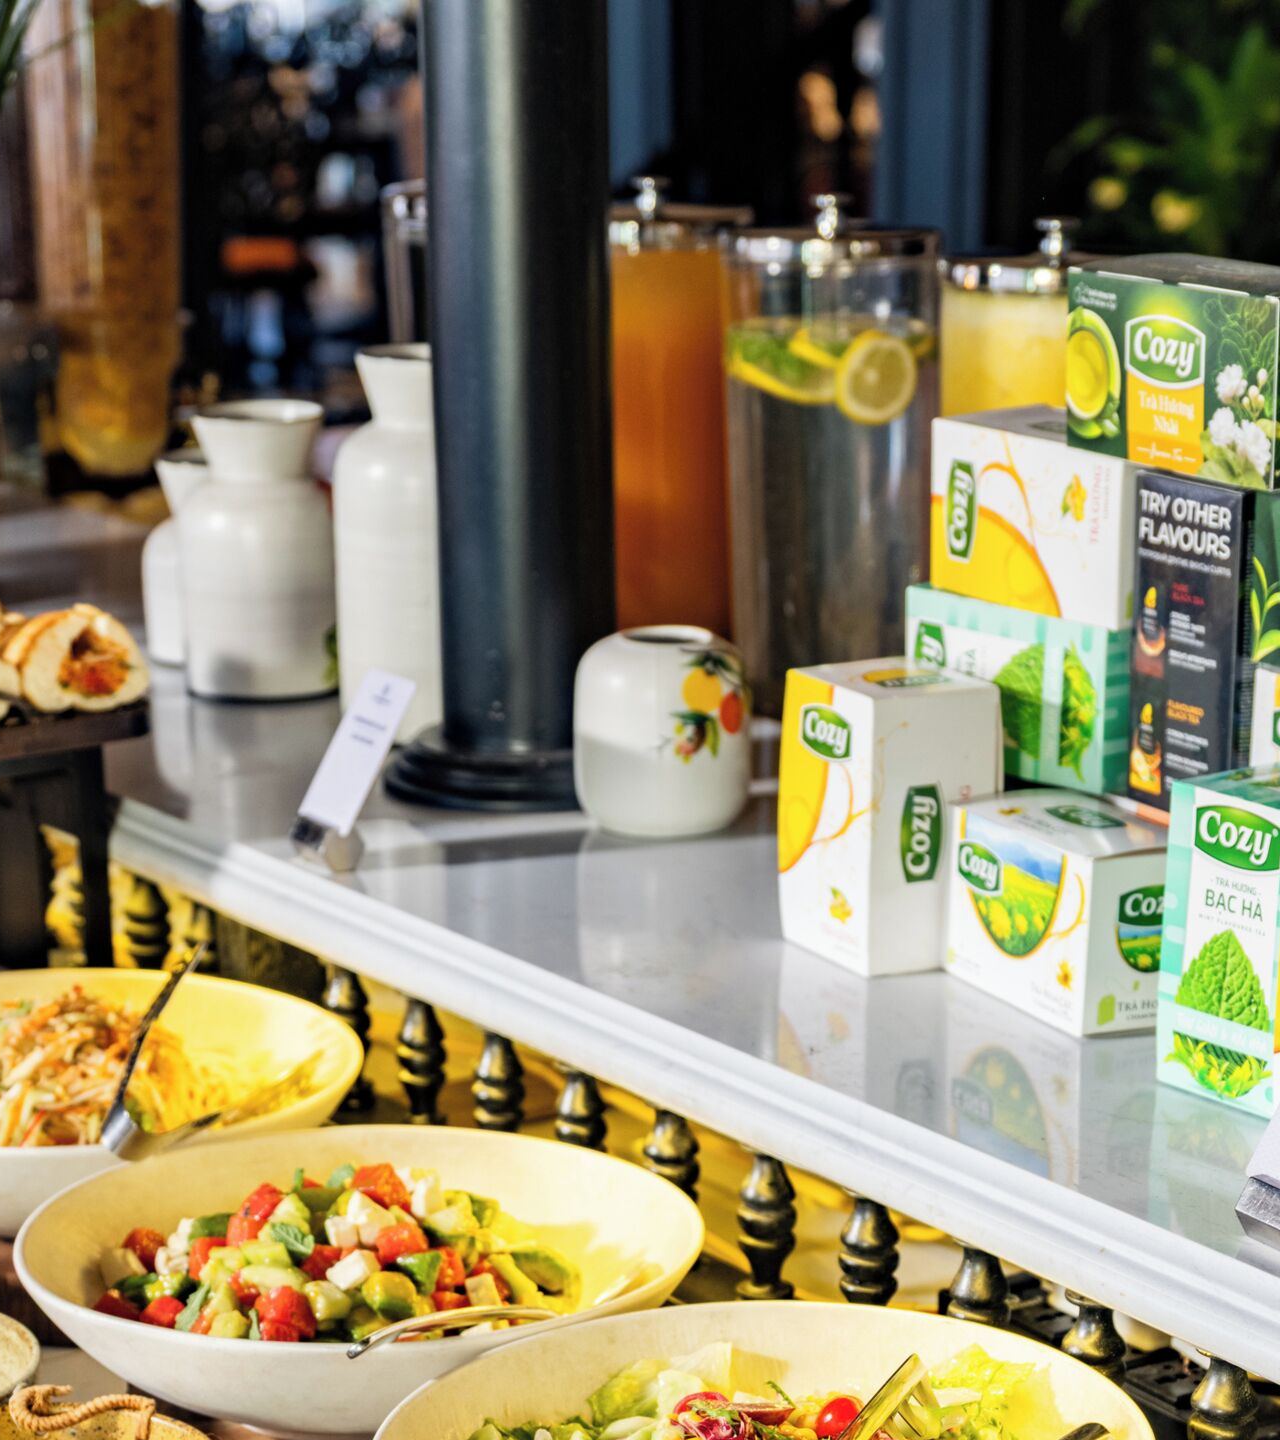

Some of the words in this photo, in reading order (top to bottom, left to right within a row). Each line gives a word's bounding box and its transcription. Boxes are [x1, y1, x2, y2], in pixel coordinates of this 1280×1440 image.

[1134, 326, 1195, 377] Cozy
[1138, 390, 1159, 408] Trà
[948, 467, 974, 551] Cozy
[1140, 489, 1171, 518] TRY
[1171, 497, 1232, 531] OTHER
[1139, 517, 1232, 560] FLAVOURS
[805, 710, 849, 756] Cozy
[906, 795, 938, 875] Cozy
[1199, 810, 1272, 865] Cozy
[960, 845, 998, 890] Cozy
[1124, 892, 1165, 917] Coz
[1205, 888, 1237, 916] BẠC
[1241, 897, 1263, 922] HÀ
